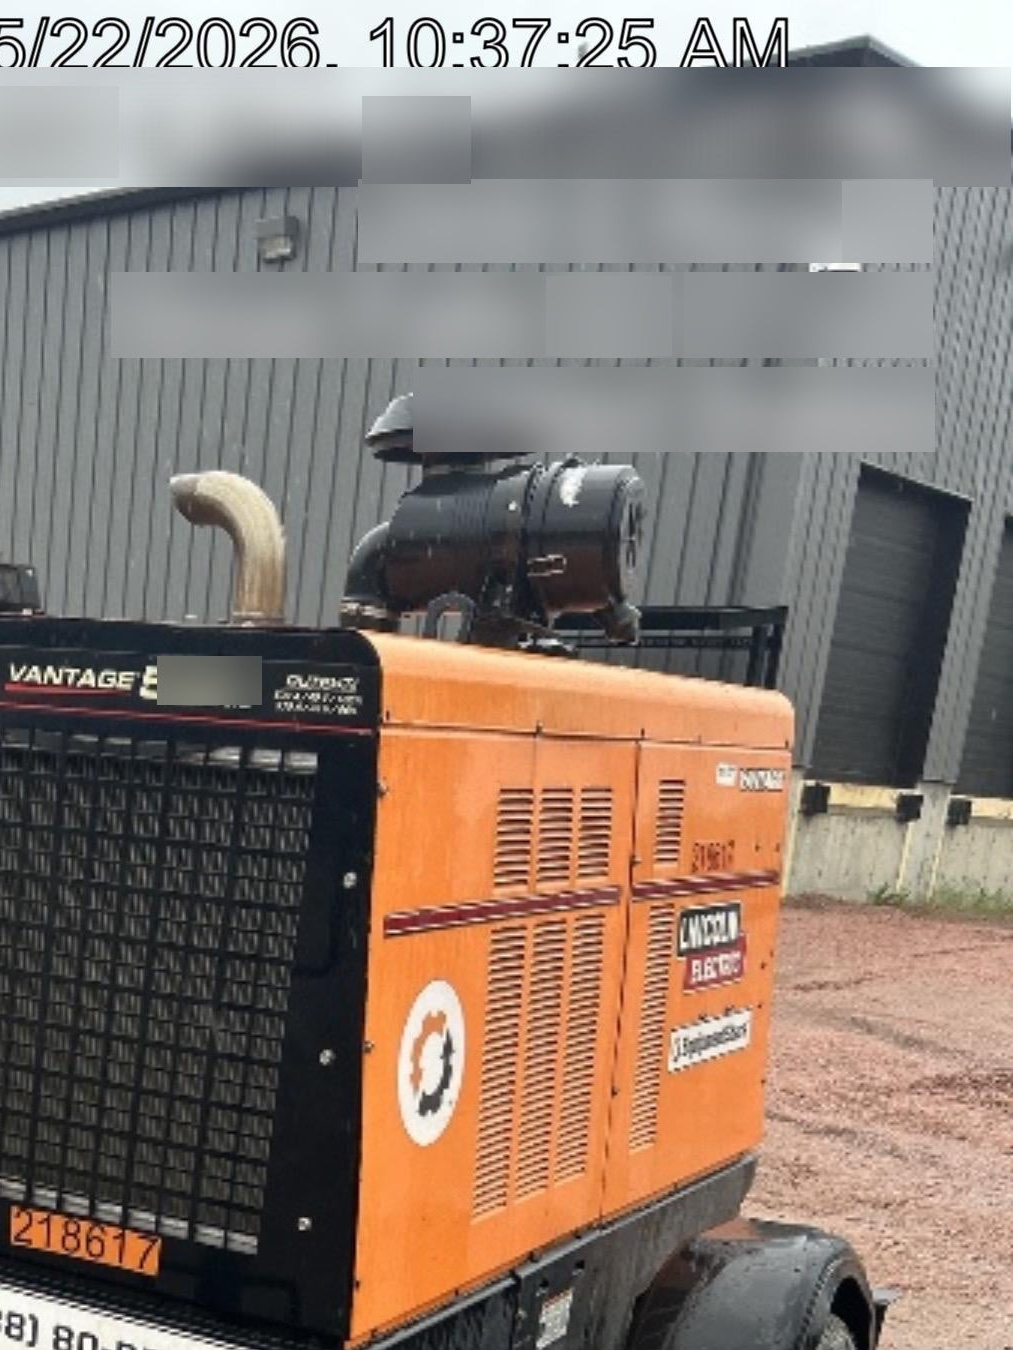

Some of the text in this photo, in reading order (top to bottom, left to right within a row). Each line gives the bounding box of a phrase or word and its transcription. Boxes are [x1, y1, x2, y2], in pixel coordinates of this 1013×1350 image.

[9, 661, 136, 691] VANTAGE
[680, 911, 738, 949] LINCOLN
[13, 1207, 159, 1270] 218617
